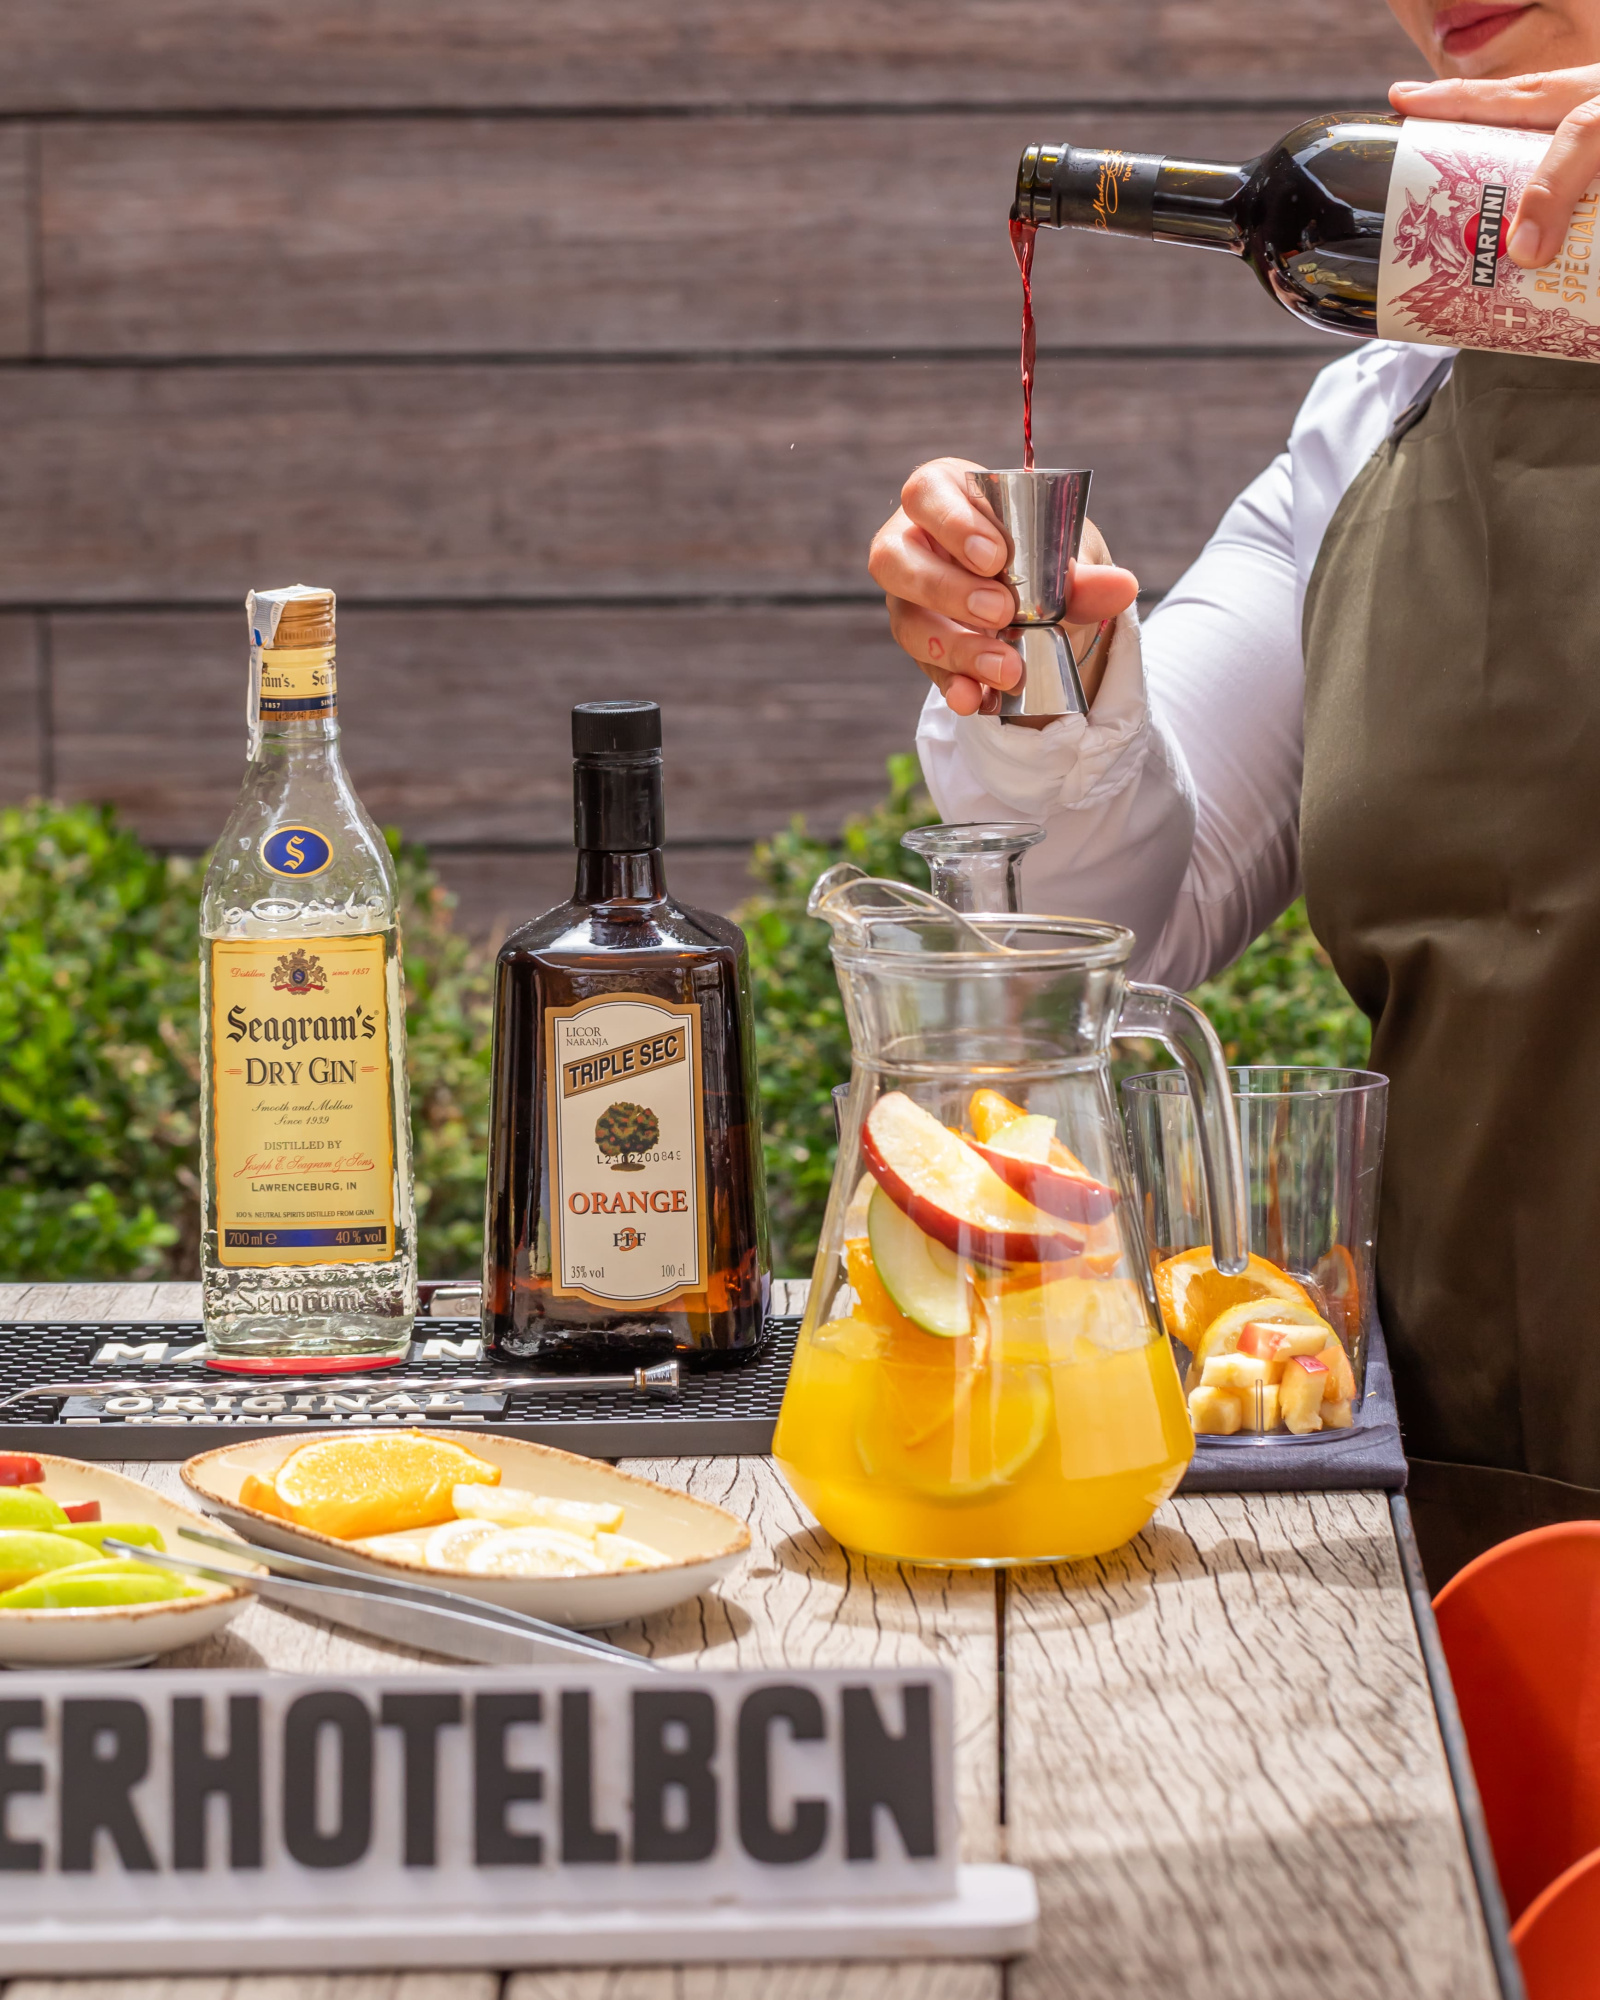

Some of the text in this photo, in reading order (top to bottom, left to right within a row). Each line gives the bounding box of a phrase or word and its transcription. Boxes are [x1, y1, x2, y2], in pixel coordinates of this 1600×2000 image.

[1474, 187, 1506, 284] MARTINI
[1562, 192, 1599, 303] SPECIALE
[283, 835, 305, 870] S
[230, 967, 371, 978] Distillers since 1857
[226, 1004, 376, 1050] Seagram's
[566, 1027, 602, 1037] LICOR
[566, 1038, 609, 1047] NARANJA
[245, 1056, 357, 1086] DRY GIN
[568, 1035, 679, 1090] TRIPLE SEC
[251, 1099, 353, 1112] Smooth and Mellow
[274, 1114, 330, 1125] Since 1939
[264, 1140, 343, 1151] DISTILLED BY
[233, 1153, 272, 1178] Joseph
[287, 1155, 331, 1172] Seagram
[333, 1158, 346, 1173] &
[251, 1181, 357, 1192] LAWRENCEBURG, IN
[568, 1190, 688, 1215] ORANGE
[229, 1232, 249, 1246] 700
[251, 1231, 263, 1245] ml
[364, 1229, 382, 1243] vol
[570, 1263, 686, 1278] 35% vol 100 cl
[104, 1395, 465, 1414] ORIGINAL
